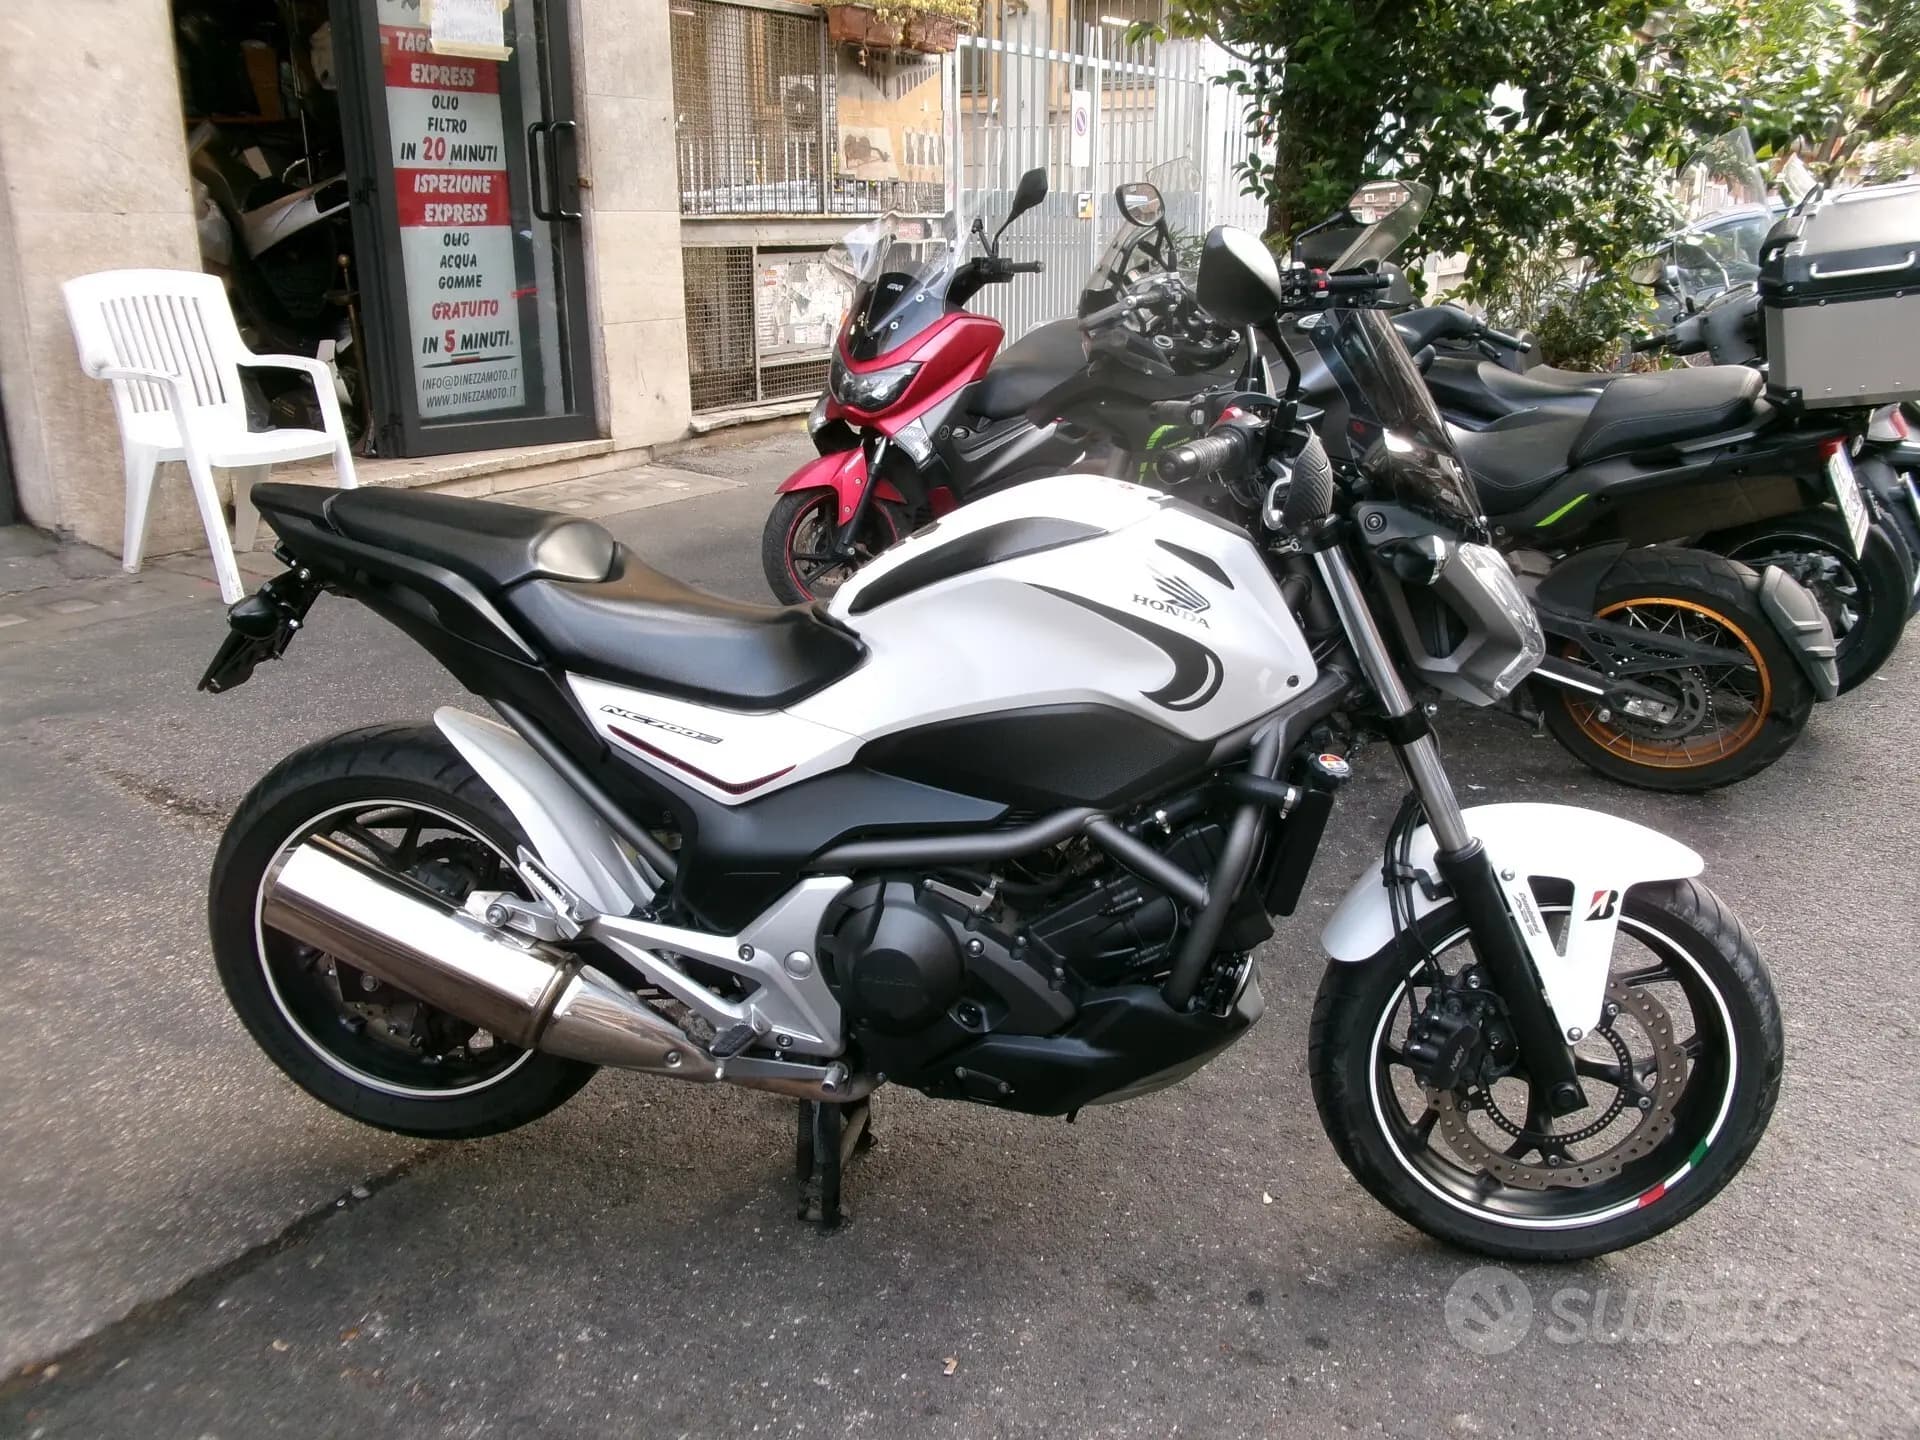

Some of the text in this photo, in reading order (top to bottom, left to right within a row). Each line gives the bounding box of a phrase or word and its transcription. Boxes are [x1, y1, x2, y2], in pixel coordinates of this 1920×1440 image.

[411, 63, 476, 87] EXPRESS
[431, 94, 459, 110] OLIO
[427, 117, 467, 133] FILTRO
[401, 136, 498, 162] IN 20 MINUTI
[414, 174, 492, 194] ISPEZIONE
[425, 203, 488, 225] EXPRESS
[443, 233, 470, 247] OLIO
[440, 254, 477, 269] ACQUA
[438, 275, 483, 290] GOMME
[431, 299, 499, 320] GRATUITO
[422, 337, 438, 354] IN
[444, 329, 456, 353] 5
[422, 368, 518, 391] INFO@DINEZZAMOTO.IT
[426, 385, 517, 409] WWW.DINEZZAMOTO.IT
[1132, 594, 1210, 629] HONDA
